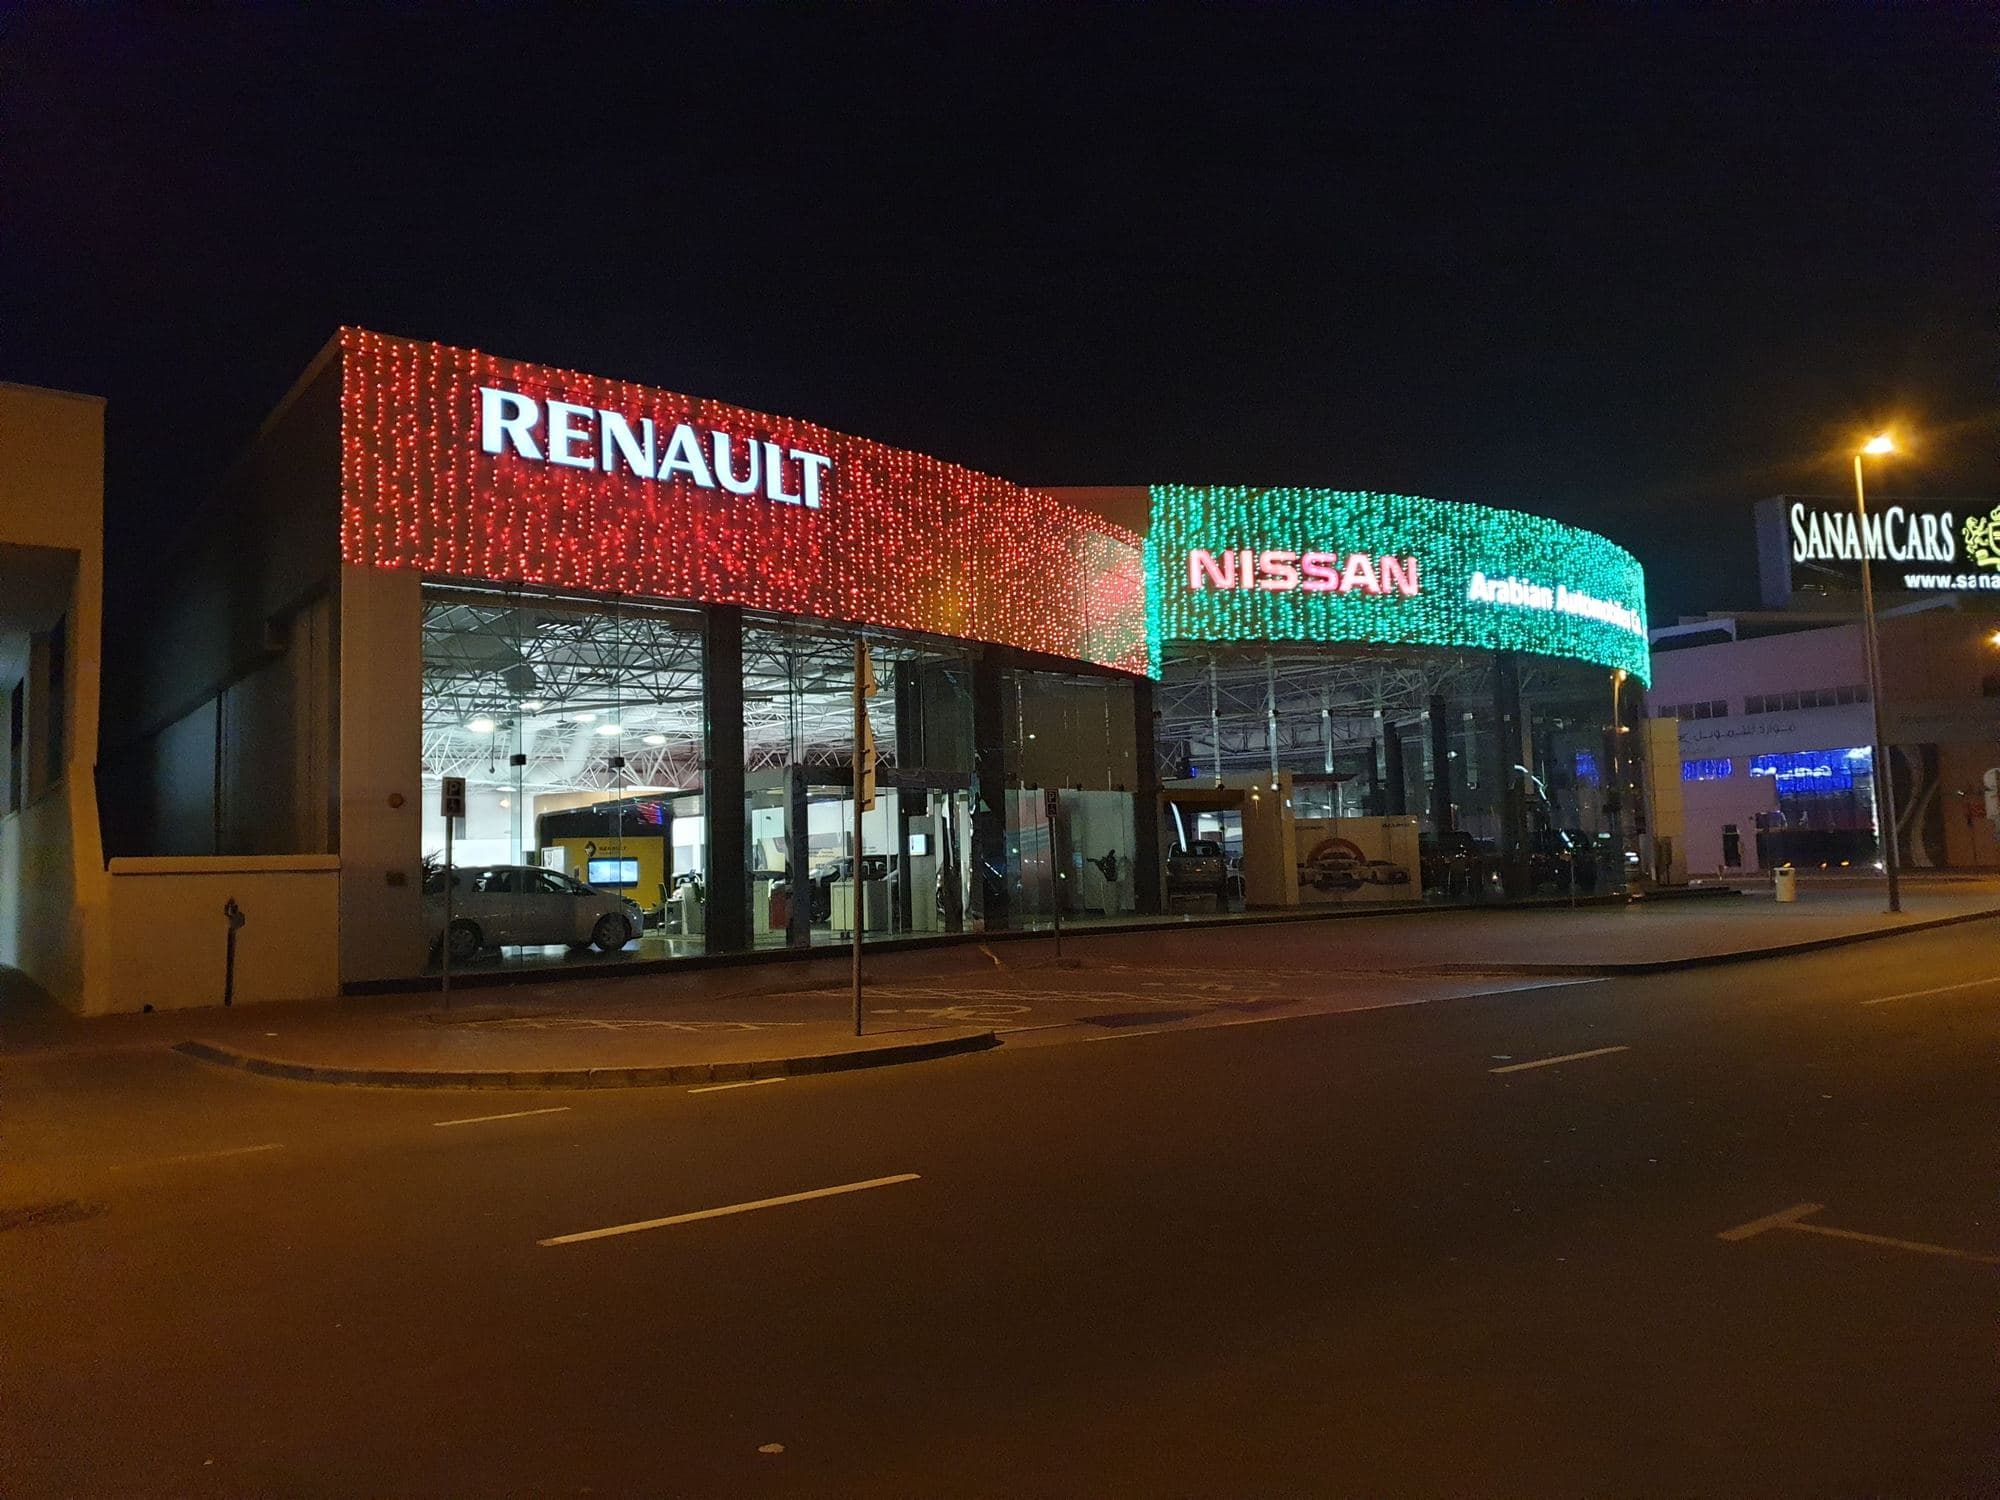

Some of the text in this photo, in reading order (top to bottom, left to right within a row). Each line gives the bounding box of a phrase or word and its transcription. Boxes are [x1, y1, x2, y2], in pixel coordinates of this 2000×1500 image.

[479, 386, 832, 510] RENAULT
[1188, 549, 1419, 596] NISSAN
[1469, 572, 1553, 610] Arabian
